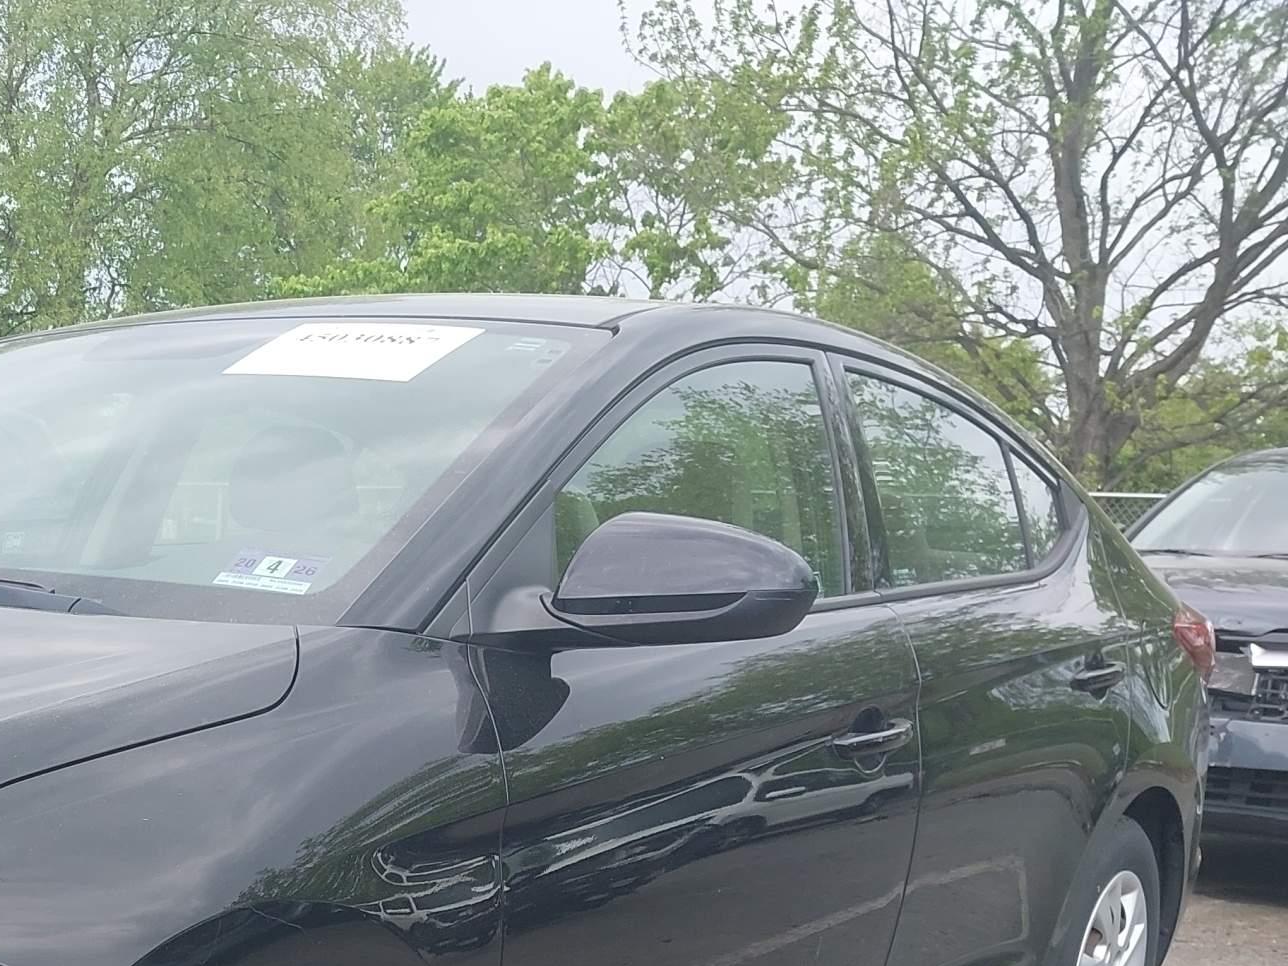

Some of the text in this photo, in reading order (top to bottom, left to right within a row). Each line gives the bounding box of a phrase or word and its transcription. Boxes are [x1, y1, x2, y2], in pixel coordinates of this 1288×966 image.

[234, 558, 317, 576] 20 4 26
